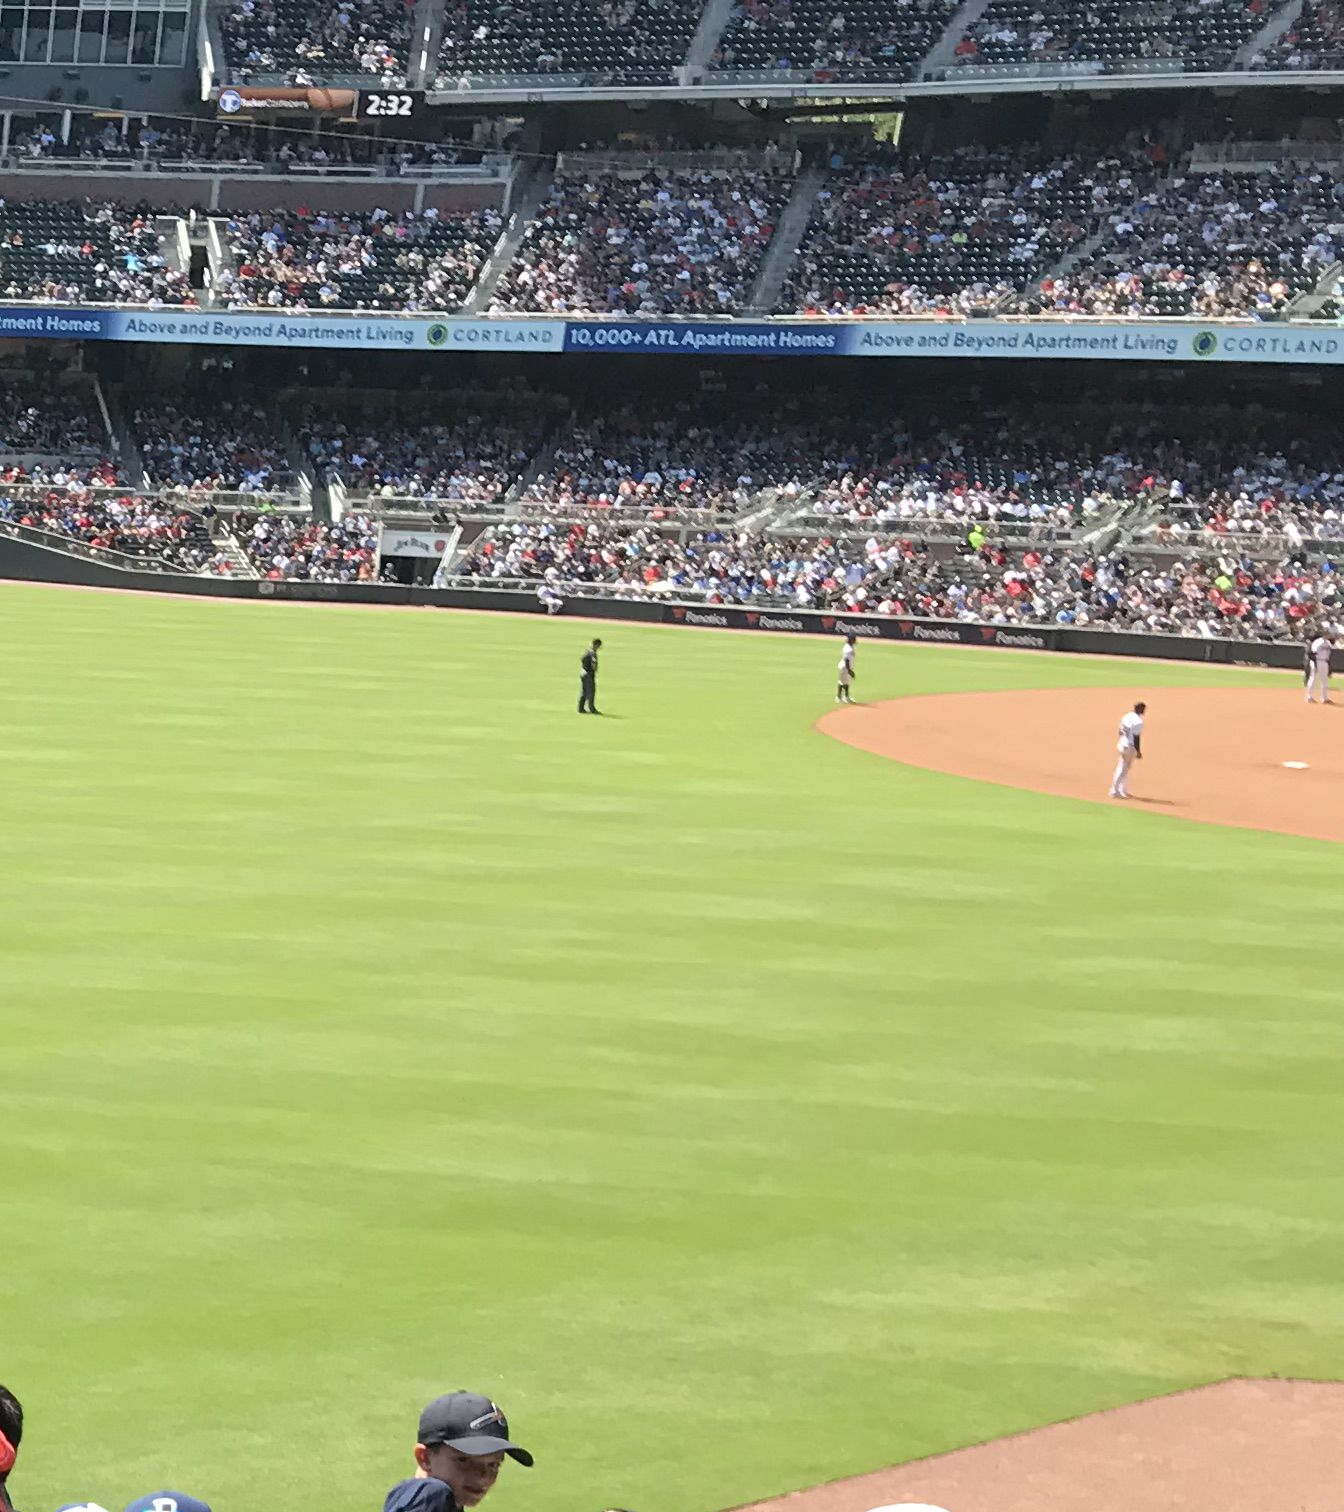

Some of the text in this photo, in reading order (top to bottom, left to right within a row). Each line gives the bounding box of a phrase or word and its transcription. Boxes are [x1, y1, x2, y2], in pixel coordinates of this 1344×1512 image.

[366, 95, 413, 116] 2:32
[46, 316, 101, 333] Homes
[125, 319, 415, 344] Above and Beyond Apartment Living
[453, 329, 554, 344] CORTLAND
[571, 329, 836, 350] 10,000+ ATL Apartment Homes
[862, 331, 1179, 354] Above and Beyond Apartment Living
[1224, 337, 1339, 354] CORTLAND
